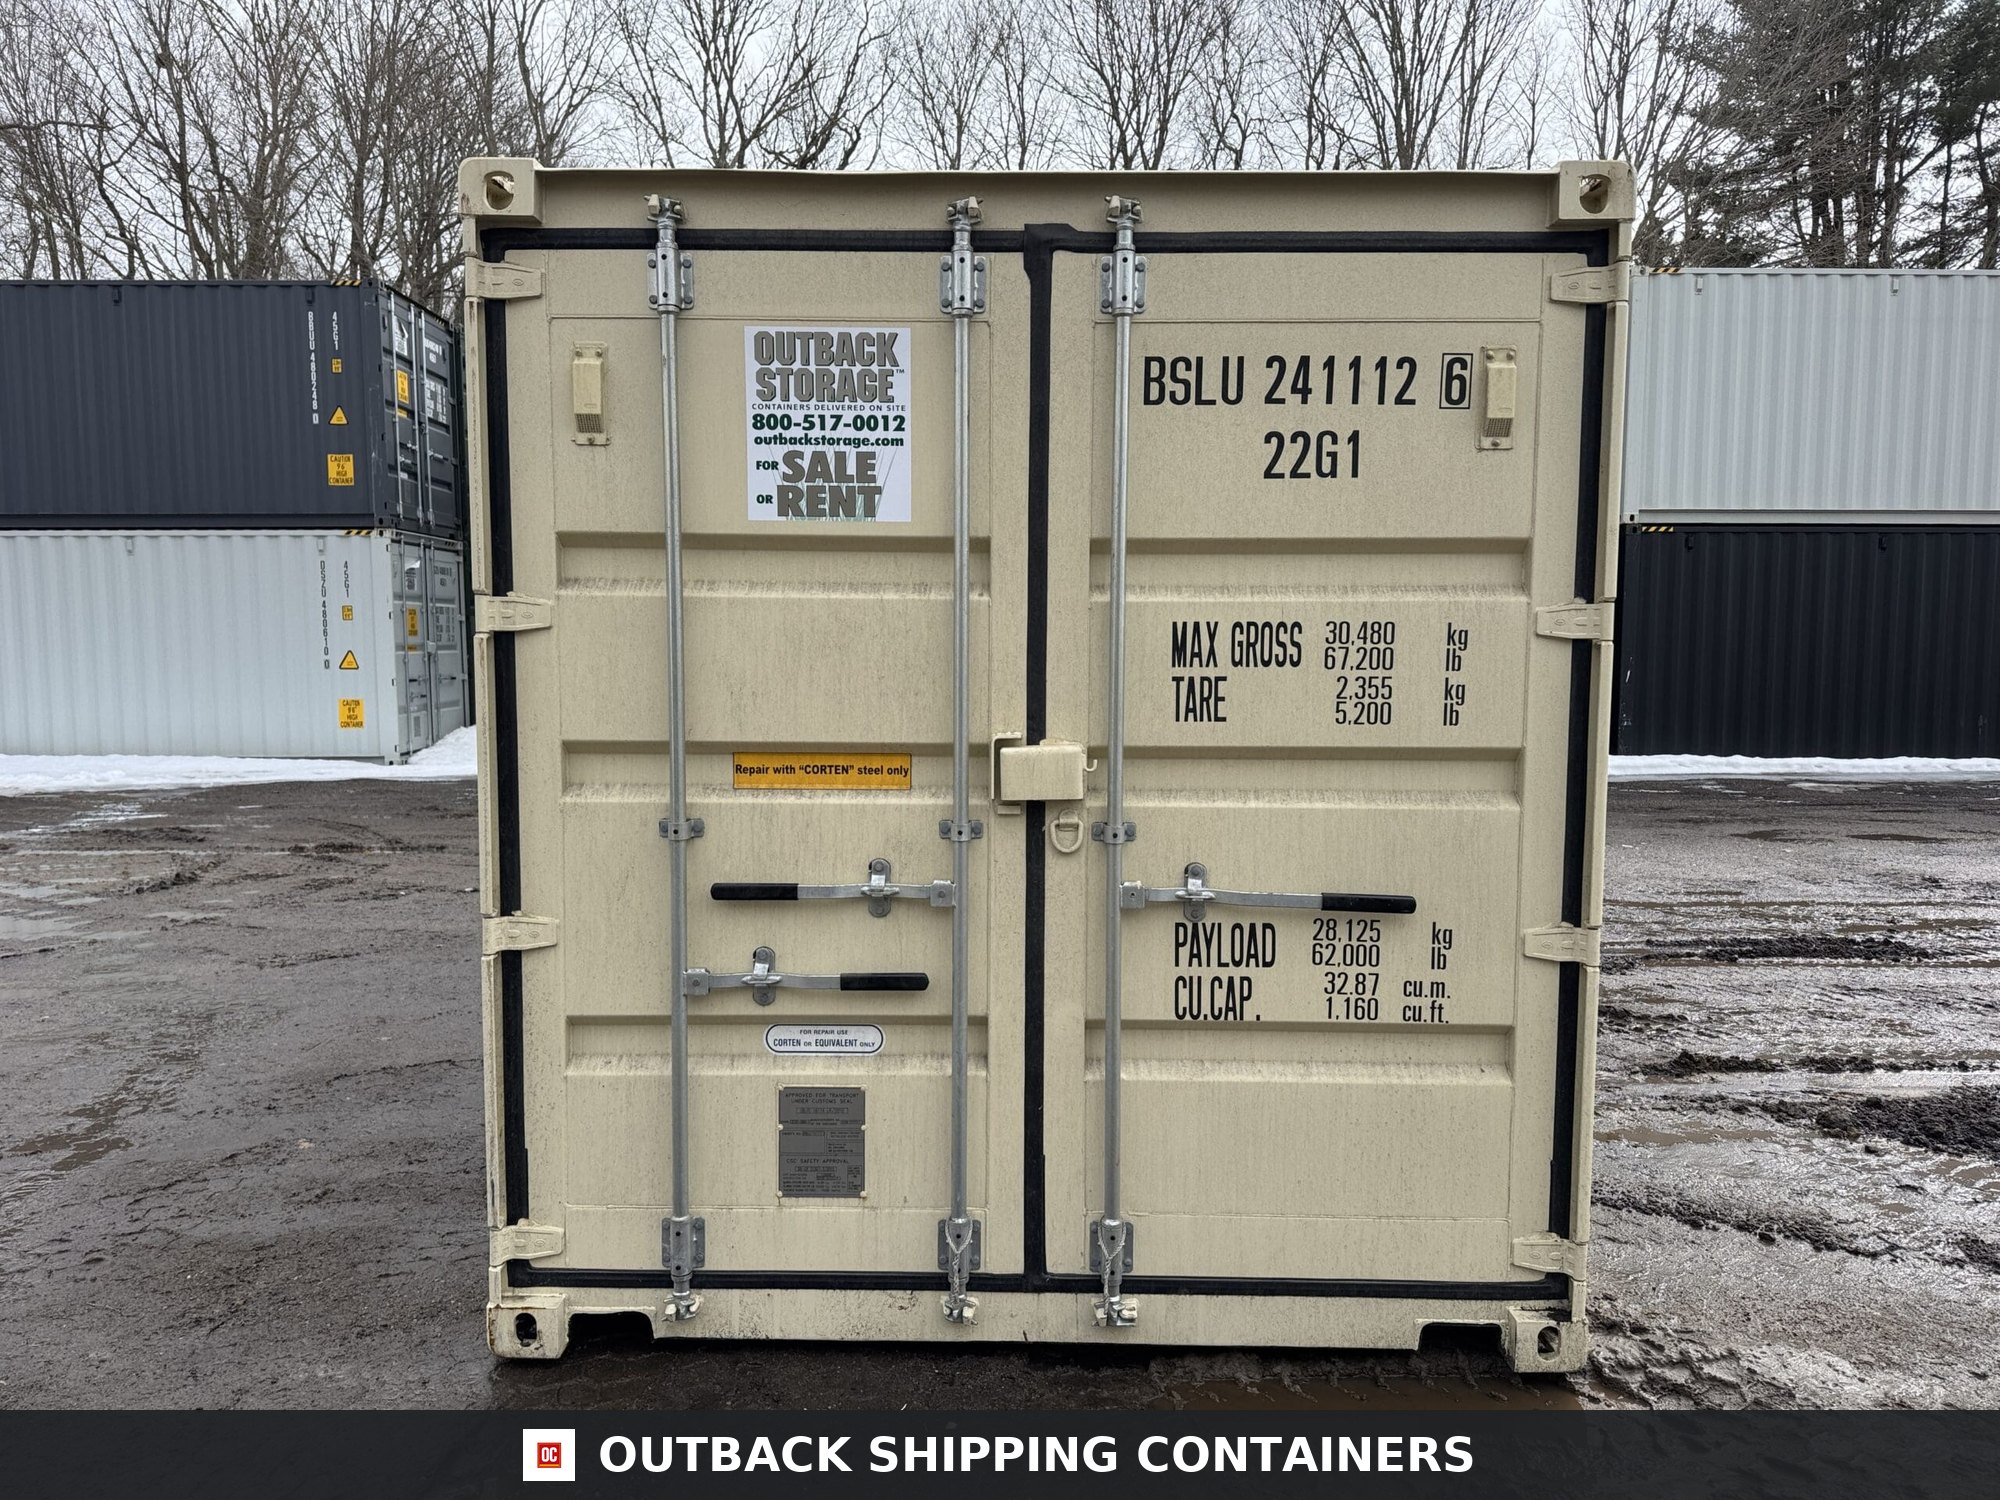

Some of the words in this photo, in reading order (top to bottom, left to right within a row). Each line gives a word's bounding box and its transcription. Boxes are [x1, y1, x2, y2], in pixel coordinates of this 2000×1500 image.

[753, 331, 900, 367] OUTBACK
[310, 352, 318, 410] 480248
[1144, 356, 1244, 405] BSLU
[1265, 355, 1416, 405] 241112
[1444, 356, 1469, 405] 6
[752, 403, 811, 411] CONTAINERS
[752, 413, 906, 432] 800-517-0012
[754, 433, 904, 449] outbackstorage.com
[1264, 430, 1359, 479] 22G1
[756, 460, 779, 471] FOR
[782, 450, 876, 484] SALE
[756, 494, 773, 504] OR
[777, 485, 882, 517] RENT
[1172, 622, 1218, 667] MAX
[1231, 621, 1302, 667] GROSS
[1326, 621, 1395, 645] 30,480
[1447, 623, 1468, 652] kg
[1325, 647, 1393, 670] 67,200
[1446, 648, 1462, 671] lb
[1172, 676, 1227, 722] TARE
[1337, 676, 1392, 700] 2,355
[1444, 678, 1465, 706] kg
[1336, 701, 1391, 725] 5,200
[1443, 703, 1459, 726] lb
[735, 764, 770, 777] Repair
[773, 764, 796, 775] with
[857, 765, 884, 775] steel
[887, 765, 909, 778] only
[1175, 923, 1275, 967] PAYLOAD
[1313, 918, 1381, 942] 28,125
[1432, 922, 1452, 951] kg
[1312, 943, 1380, 967] 62,000
[1431, 946, 1447, 970] lb
[1324, 972, 1379, 995] 32.87
[1404, 981, 1450, 998] cu.m.
[1327, 997, 1378, 1020] 1,160
[1403, 1000, 1448, 1025] cu.ft.
[773, 1038, 801, 1047] CORTEN
[815, 1039, 858, 1047] EQUIVALENT
